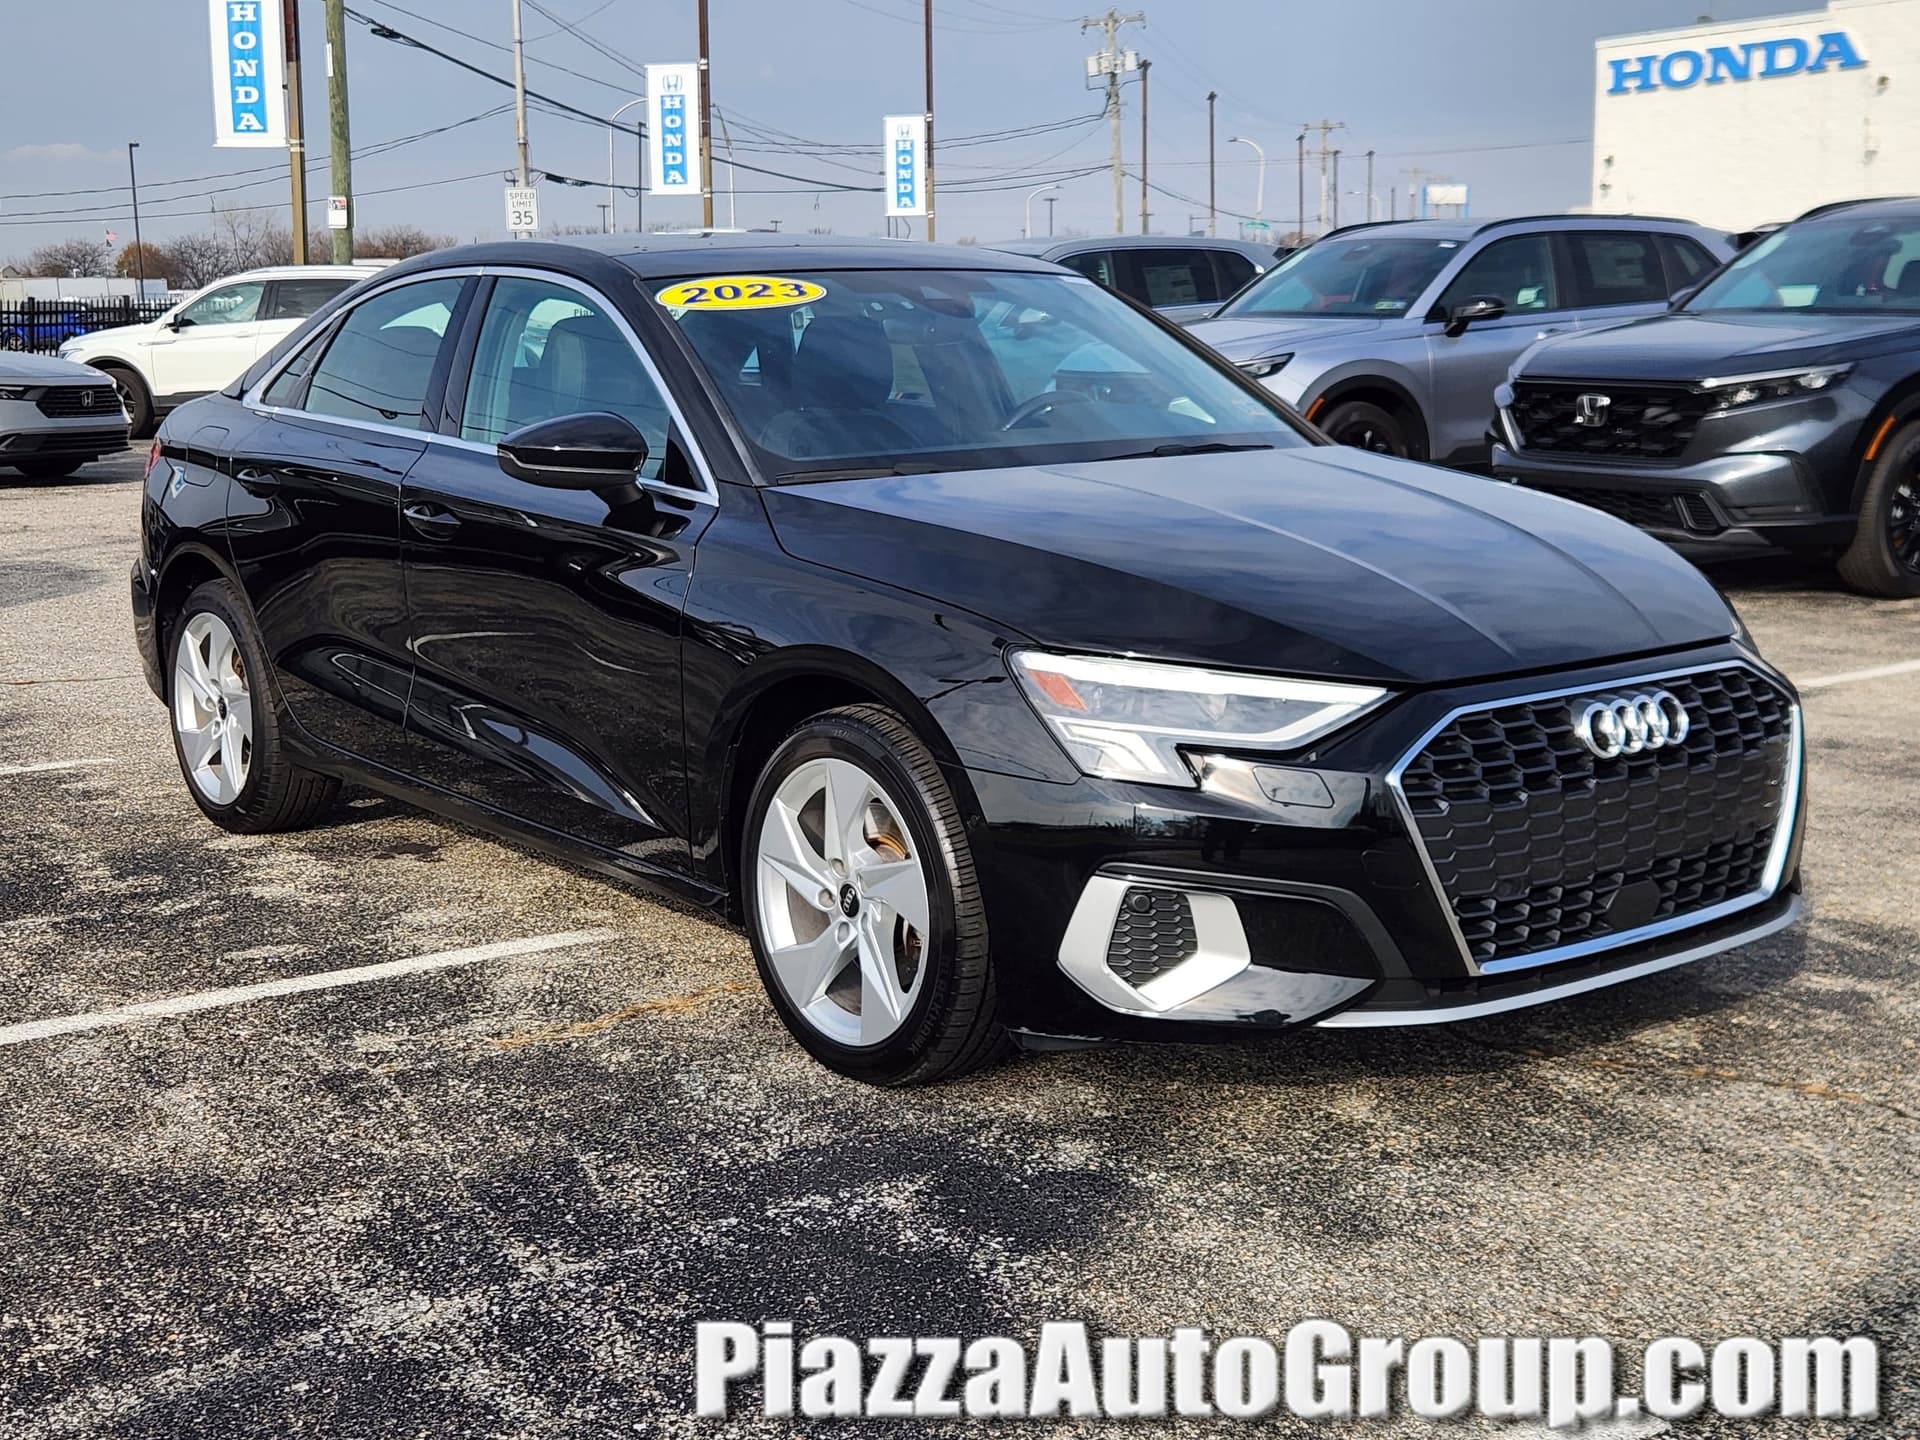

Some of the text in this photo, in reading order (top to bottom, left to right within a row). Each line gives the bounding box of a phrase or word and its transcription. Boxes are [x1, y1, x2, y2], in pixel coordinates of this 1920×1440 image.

[229, 3, 264, 131] HONDA
[1607, 31, 1870, 95] HONDA
[663, 96, 685, 184] HONDA
[508, 191, 535, 200] SPEED
[897, 140, 914, 208] HONDA
[511, 200, 532, 208] LIMIT
[511, 210, 534, 225] 35
[681, 283, 808, 305] 2023
